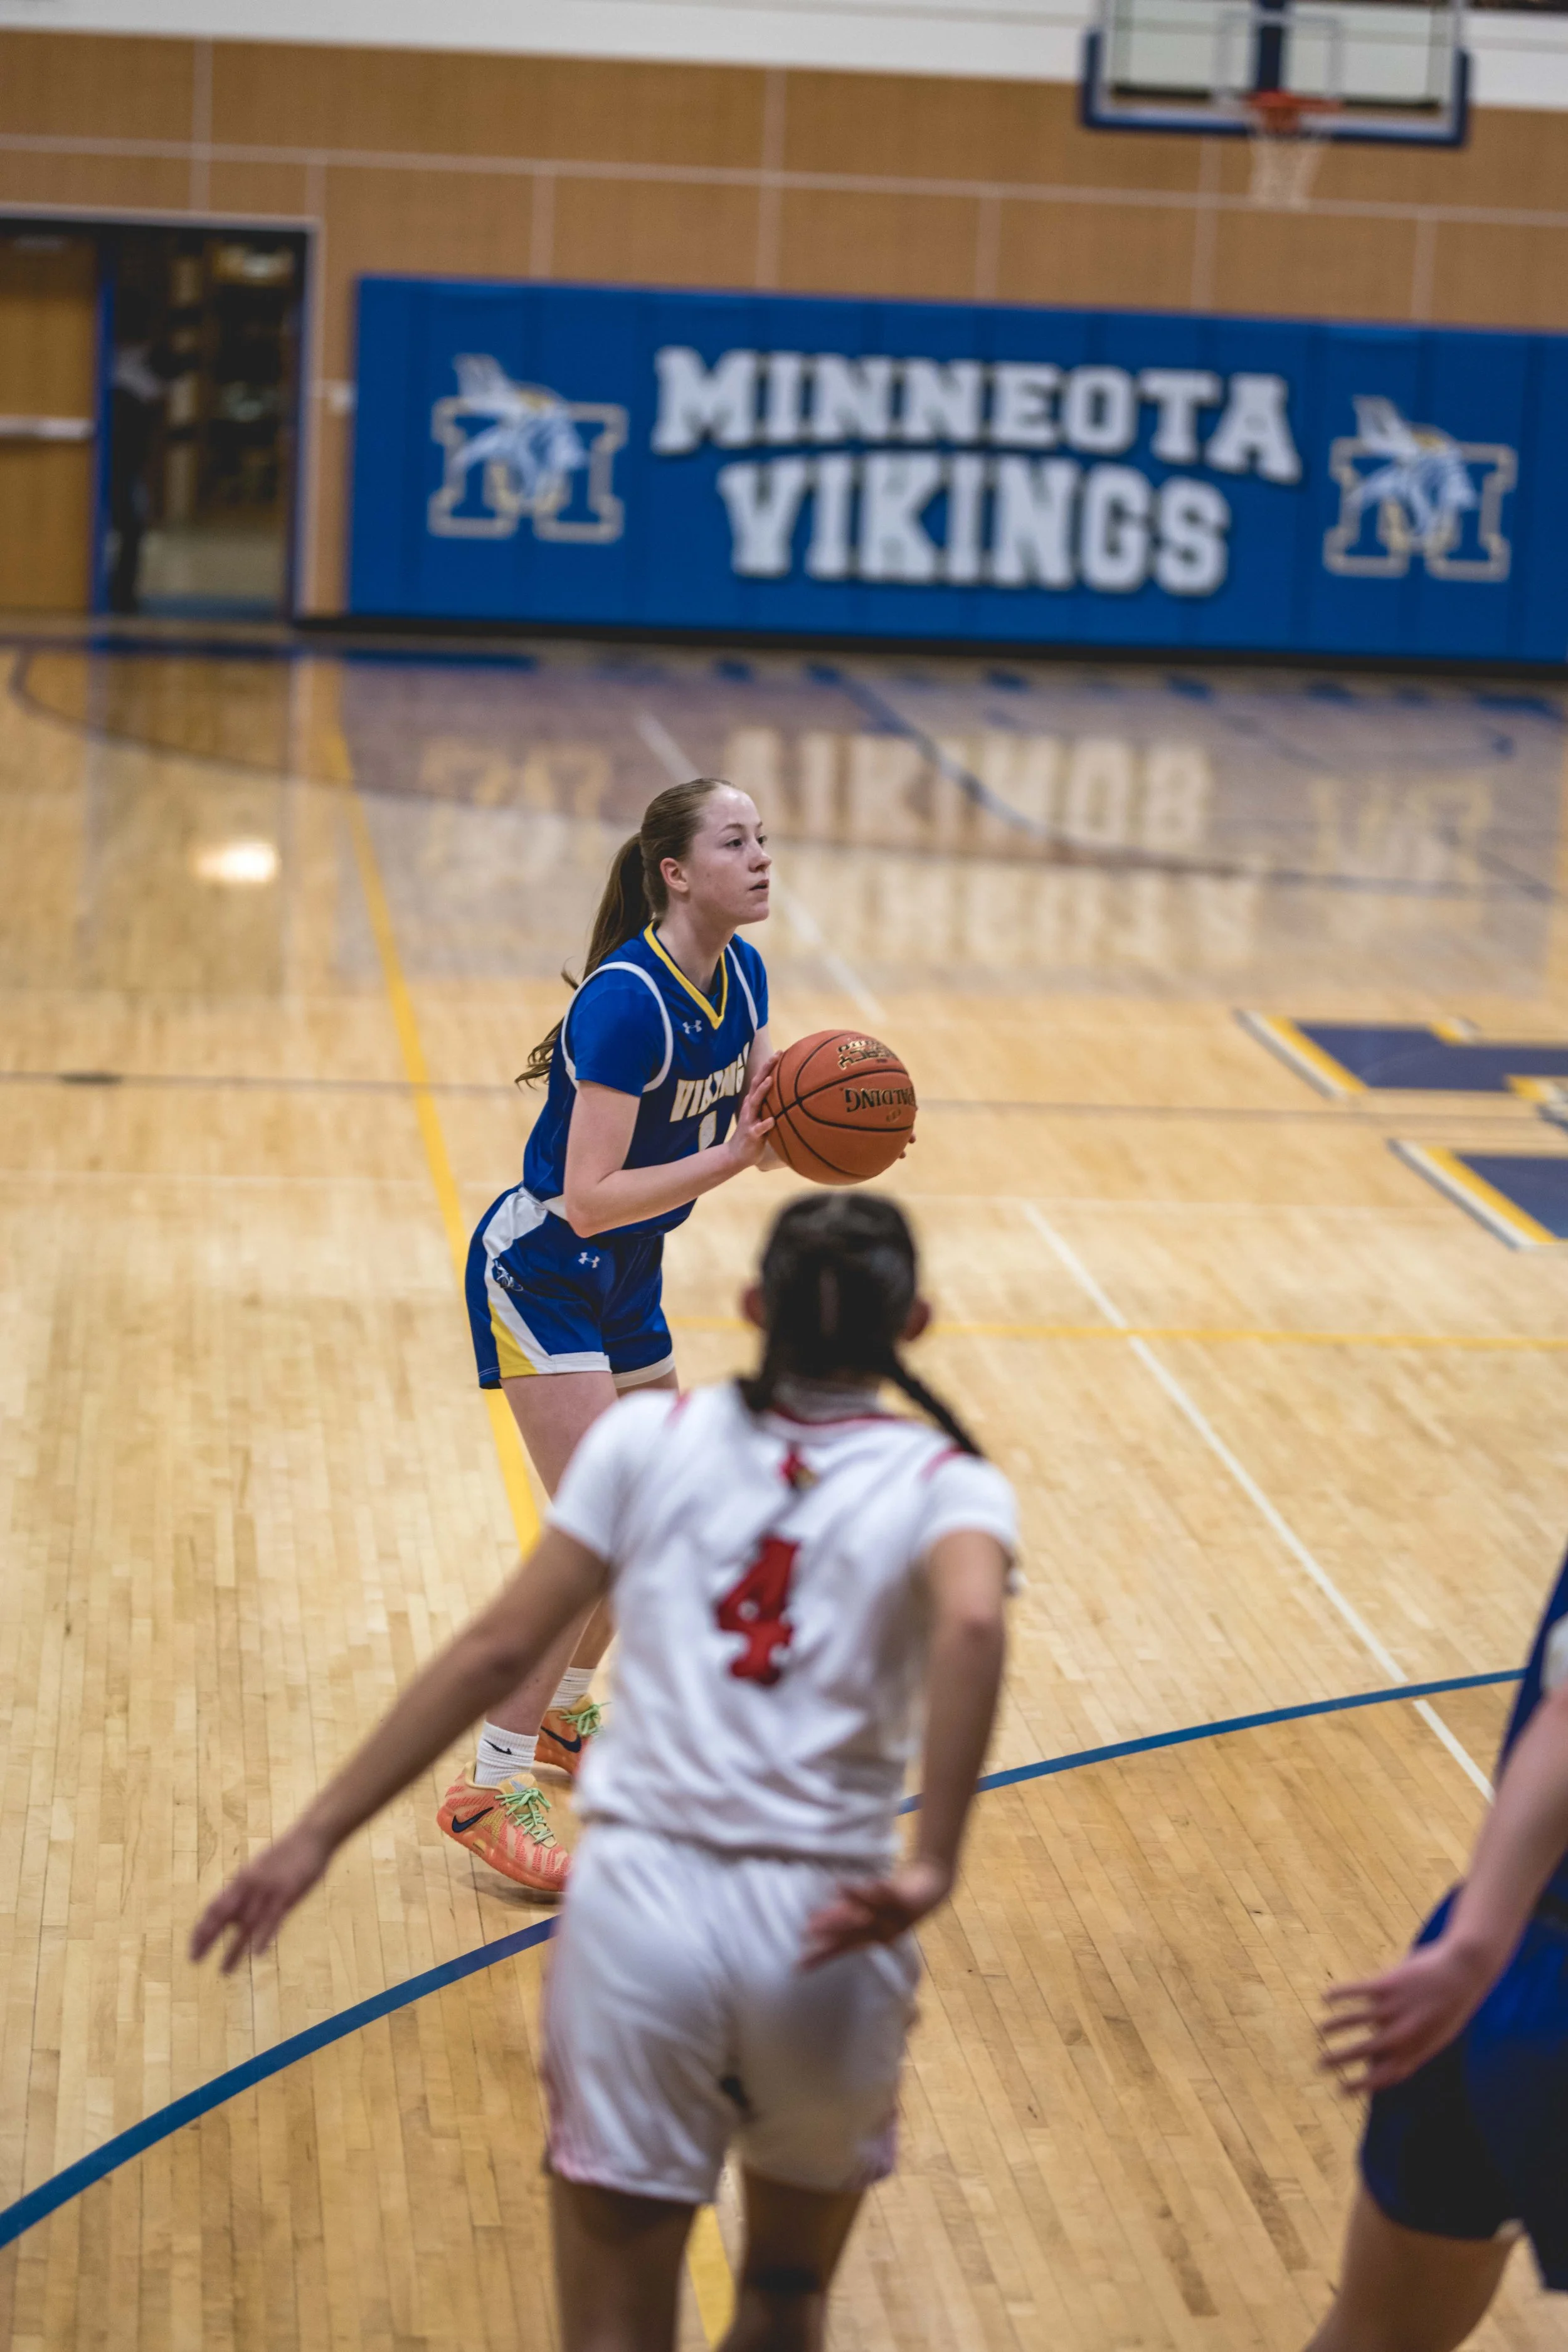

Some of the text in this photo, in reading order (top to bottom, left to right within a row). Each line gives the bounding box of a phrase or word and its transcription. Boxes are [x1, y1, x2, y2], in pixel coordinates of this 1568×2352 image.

[650, 346, 1303, 485] MINNEOTA
[715, 449, 1231, 598] VIKINGS
[844, 1086, 917, 1113] PALDING
[716, 1535, 800, 1683] 4
